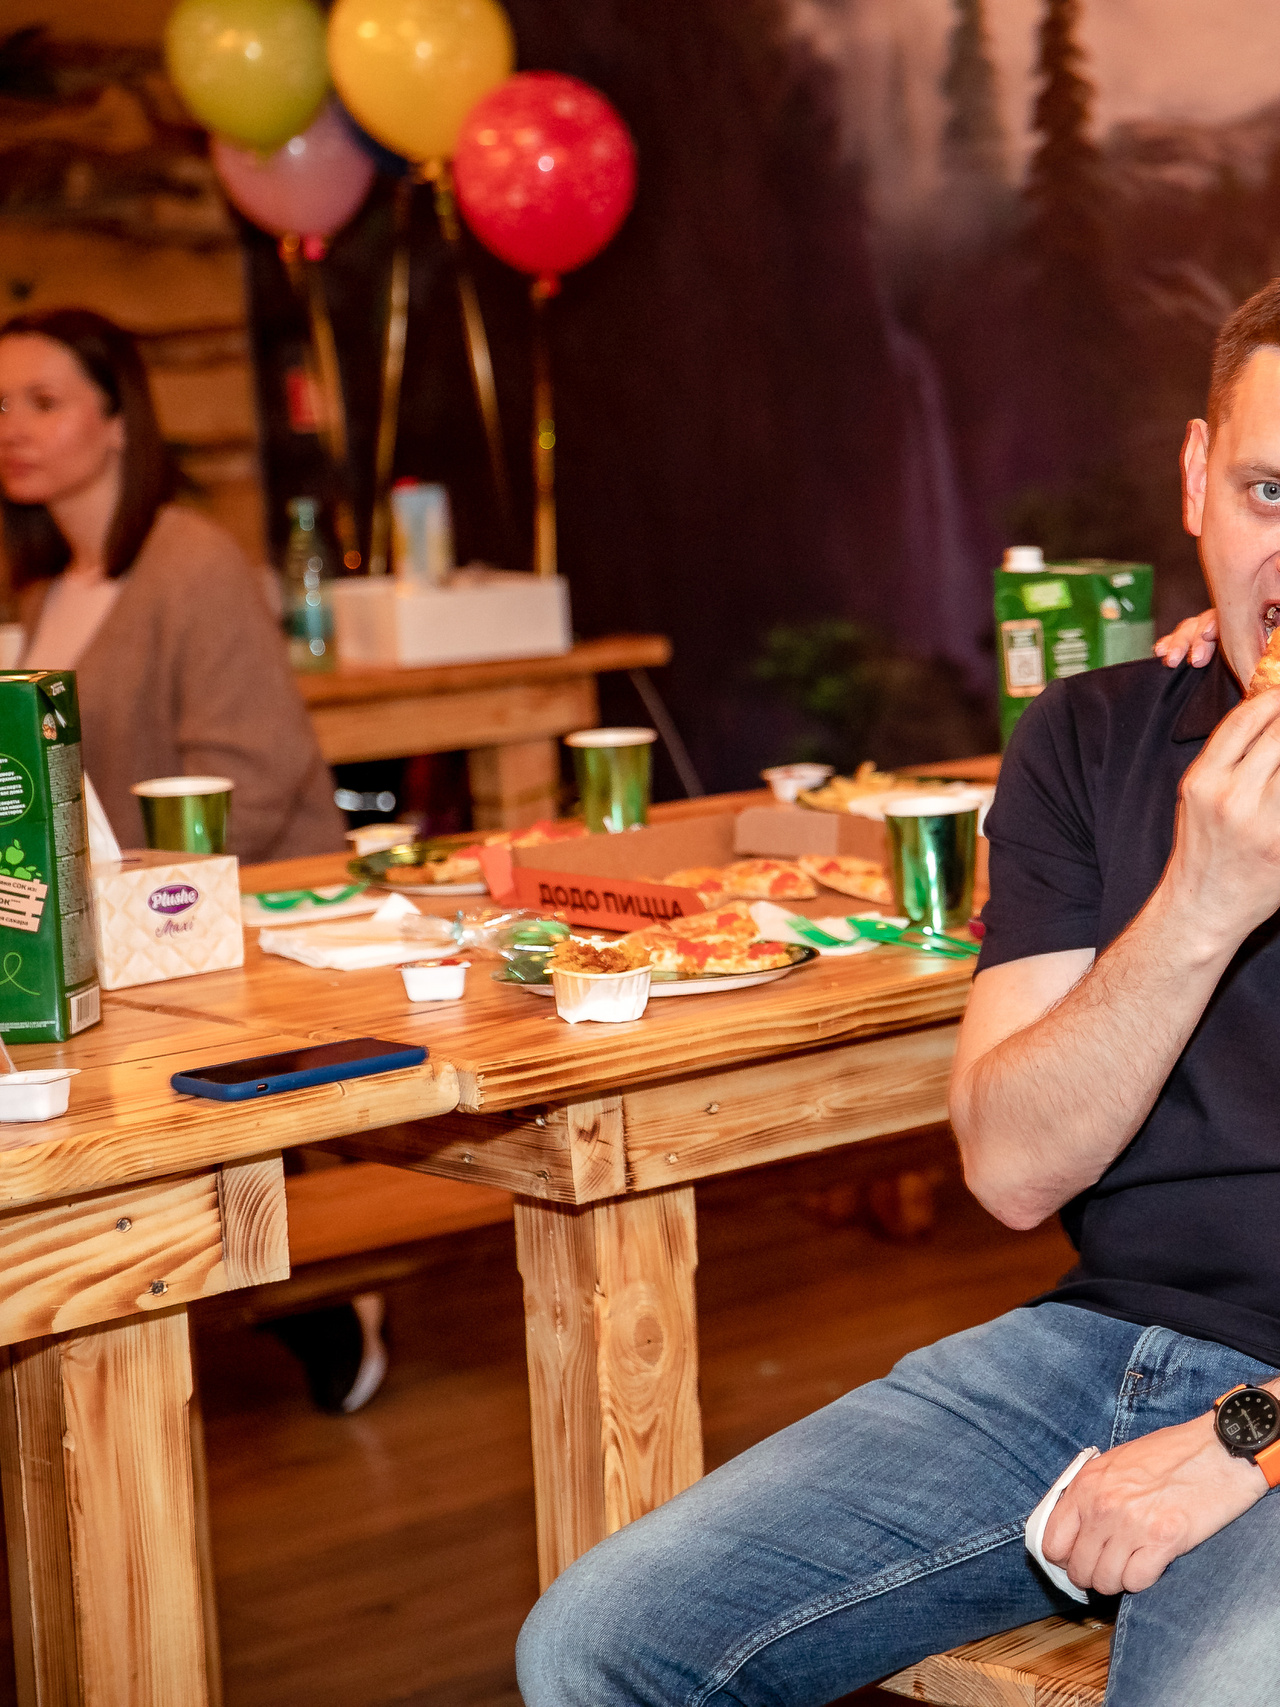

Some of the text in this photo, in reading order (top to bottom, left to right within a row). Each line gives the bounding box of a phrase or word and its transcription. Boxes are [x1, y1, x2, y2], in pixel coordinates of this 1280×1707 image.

[151, 889, 197, 909] Plushe
[538, 882, 685, 923] ДОДО ПИЦЦА
[155, 916, 194, 938] Maxi
